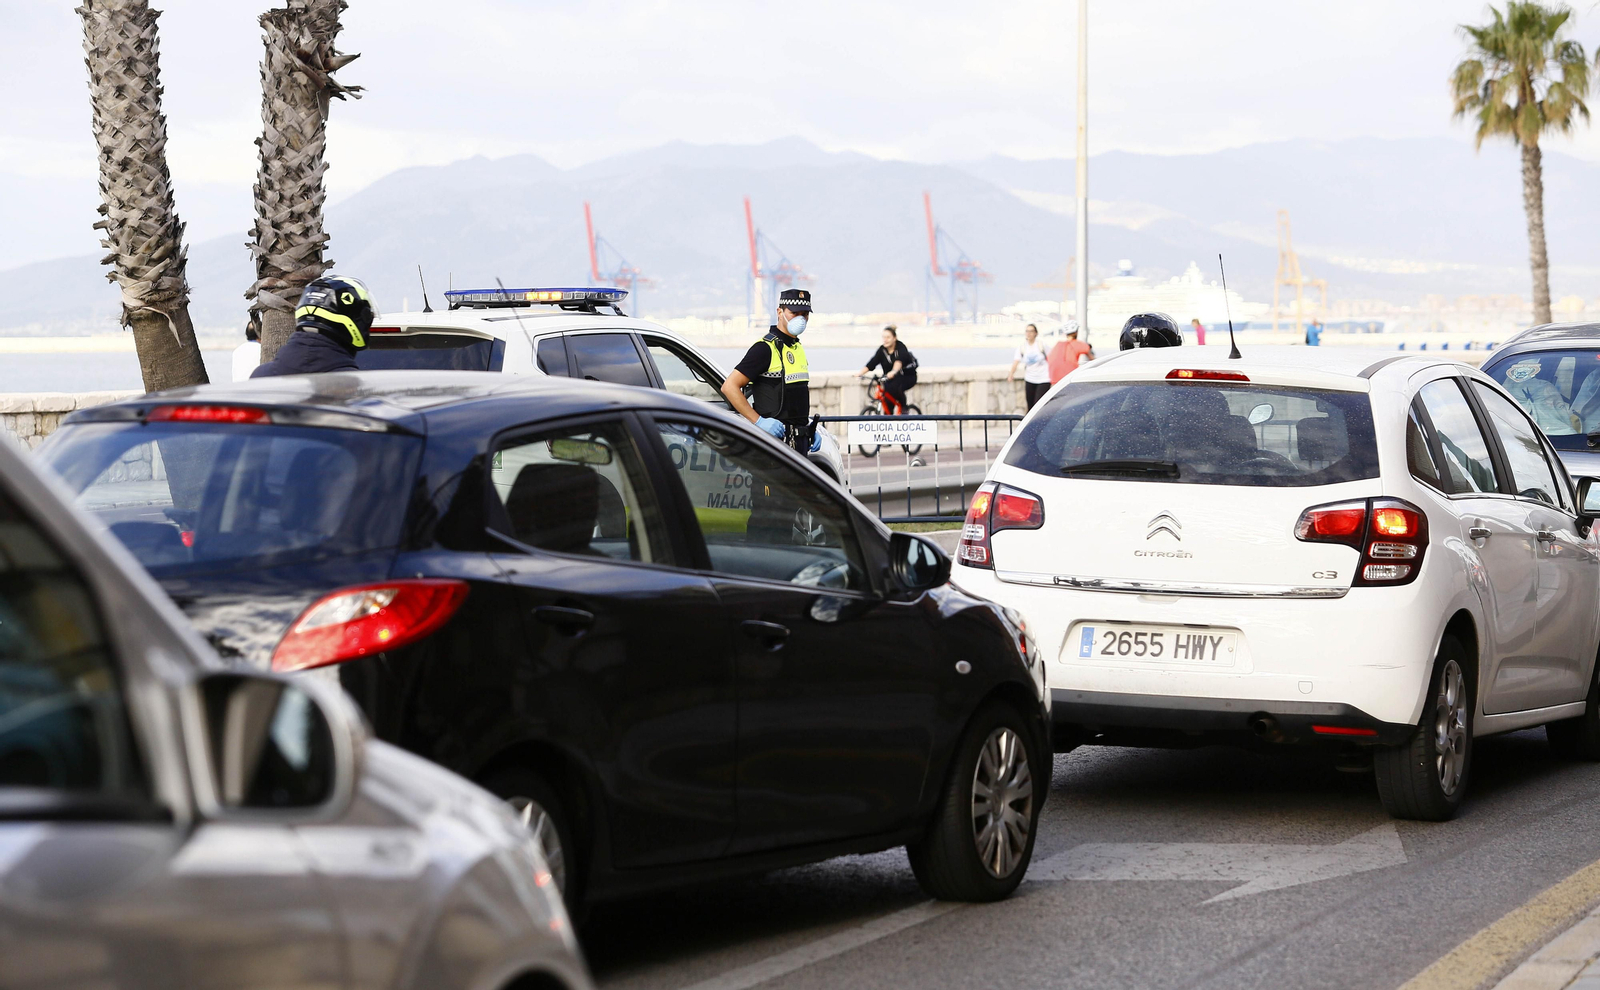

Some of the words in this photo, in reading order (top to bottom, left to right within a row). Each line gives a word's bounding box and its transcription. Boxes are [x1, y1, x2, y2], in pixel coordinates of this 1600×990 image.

[858, 423, 893, 431] POLICIA
[897, 423, 926, 431] LOCAL
[873, 433, 911, 442] MALAGA
[667, 443, 747, 472] OLIC
[724, 474, 752, 489] LOC
[707, 490, 754, 509] MÁLA
[1312, 570, 1338, 579] C3
[1082, 645, 1090, 653] E
[1100, 631, 1164, 658] 2655
[1173, 634, 1223, 661] HWY
